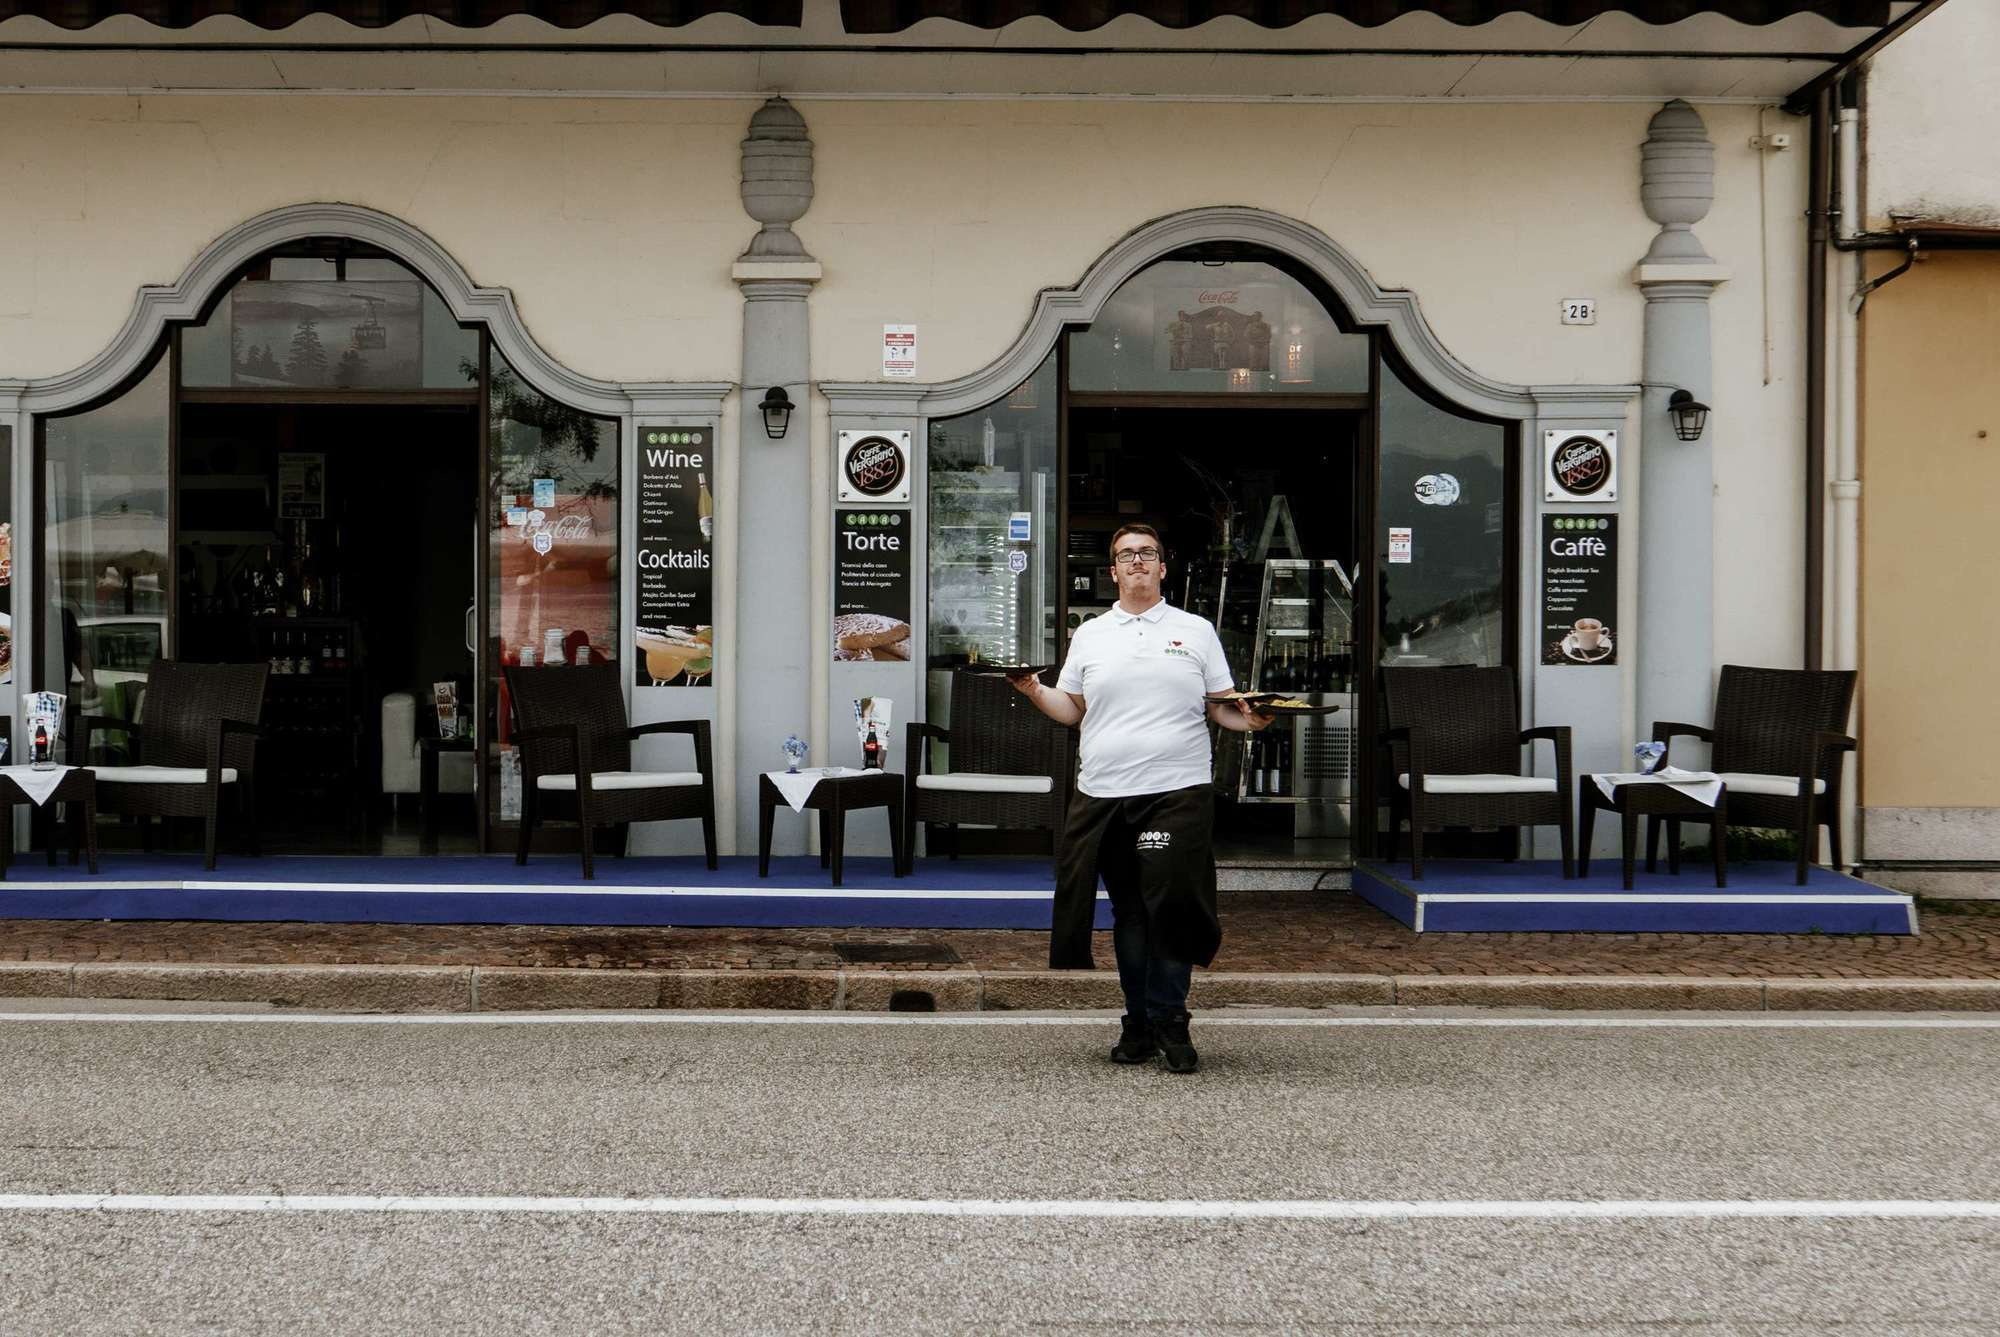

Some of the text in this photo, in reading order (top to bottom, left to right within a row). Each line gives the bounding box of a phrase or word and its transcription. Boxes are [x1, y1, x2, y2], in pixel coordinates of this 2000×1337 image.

[1570, 305, 1588, 319] 28
[646, 448, 703, 468] Wine
[849, 447, 895, 474] VERGNANO
[1555, 446, 1602, 474] VERGNANO
[860, 458, 895, 487] 1882
[1567, 458, 1602, 486] 1882
[842, 531, 901, 551] Torte
[1550, 537, 1607, 556] Caffè
[638, 549, 710, 569] Cocktails
